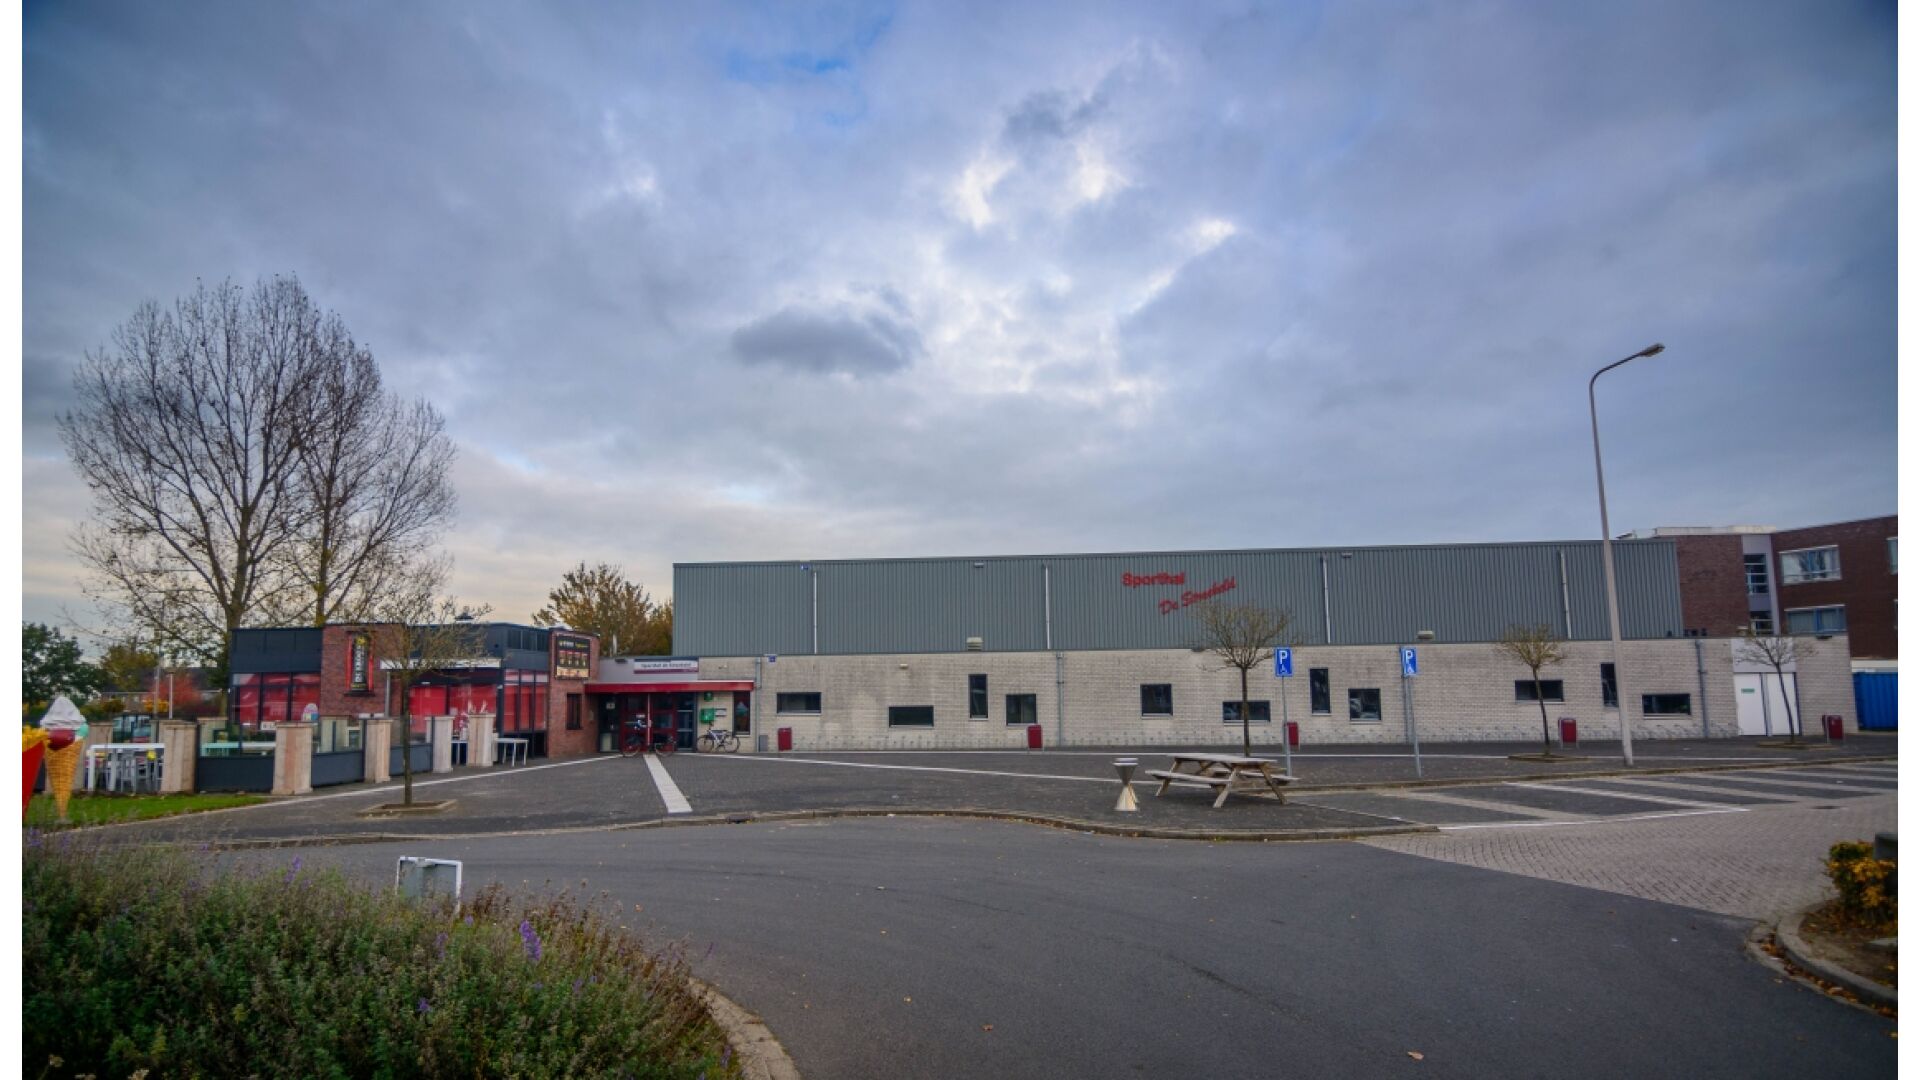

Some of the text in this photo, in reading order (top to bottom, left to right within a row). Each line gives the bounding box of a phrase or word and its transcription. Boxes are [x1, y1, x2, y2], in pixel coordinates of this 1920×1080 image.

[1122, 572, 1185, 588] Sporthal
[1279, 650, 1288, 664] P
[1405, 650, 1414, 663] P
